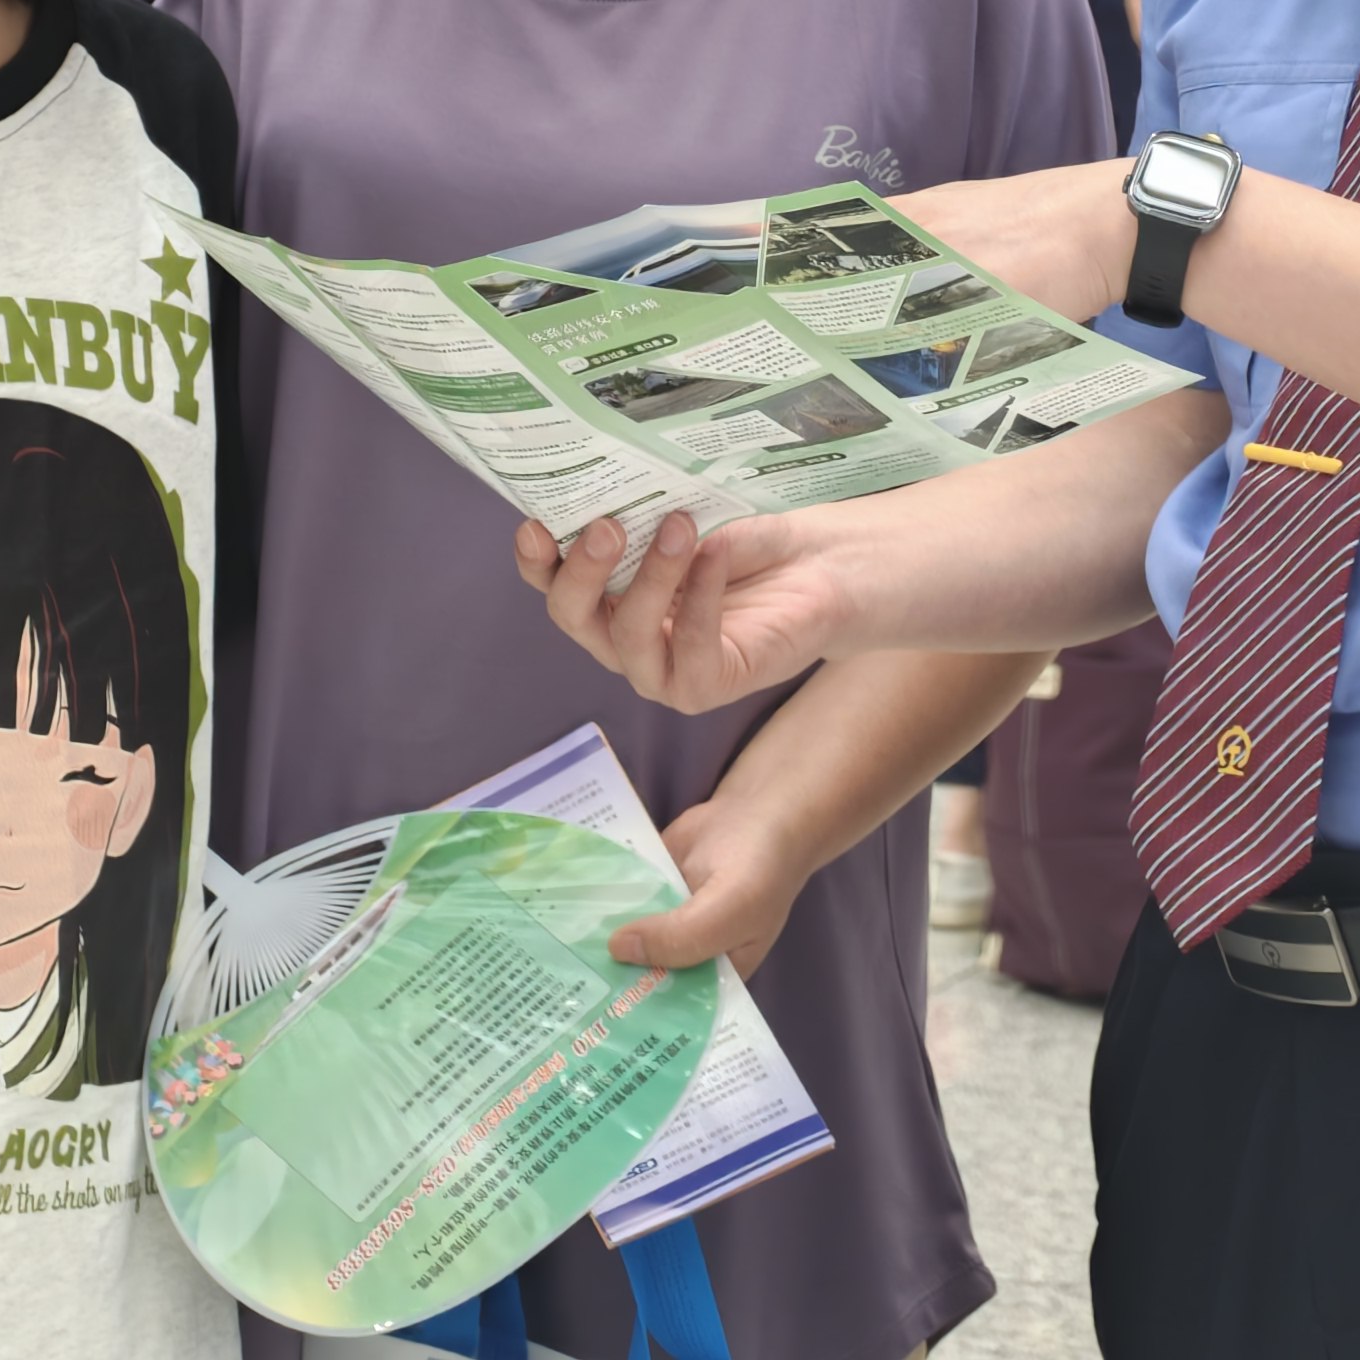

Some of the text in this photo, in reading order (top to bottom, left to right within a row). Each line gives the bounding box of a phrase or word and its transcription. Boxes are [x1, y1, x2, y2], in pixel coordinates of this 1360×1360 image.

[815, 125, 905, 188] Barbie
[16, 1183, 48, 1214] the
[51, 1177, 100, 1211] shots
[104, 1183, 122, 1206] on
